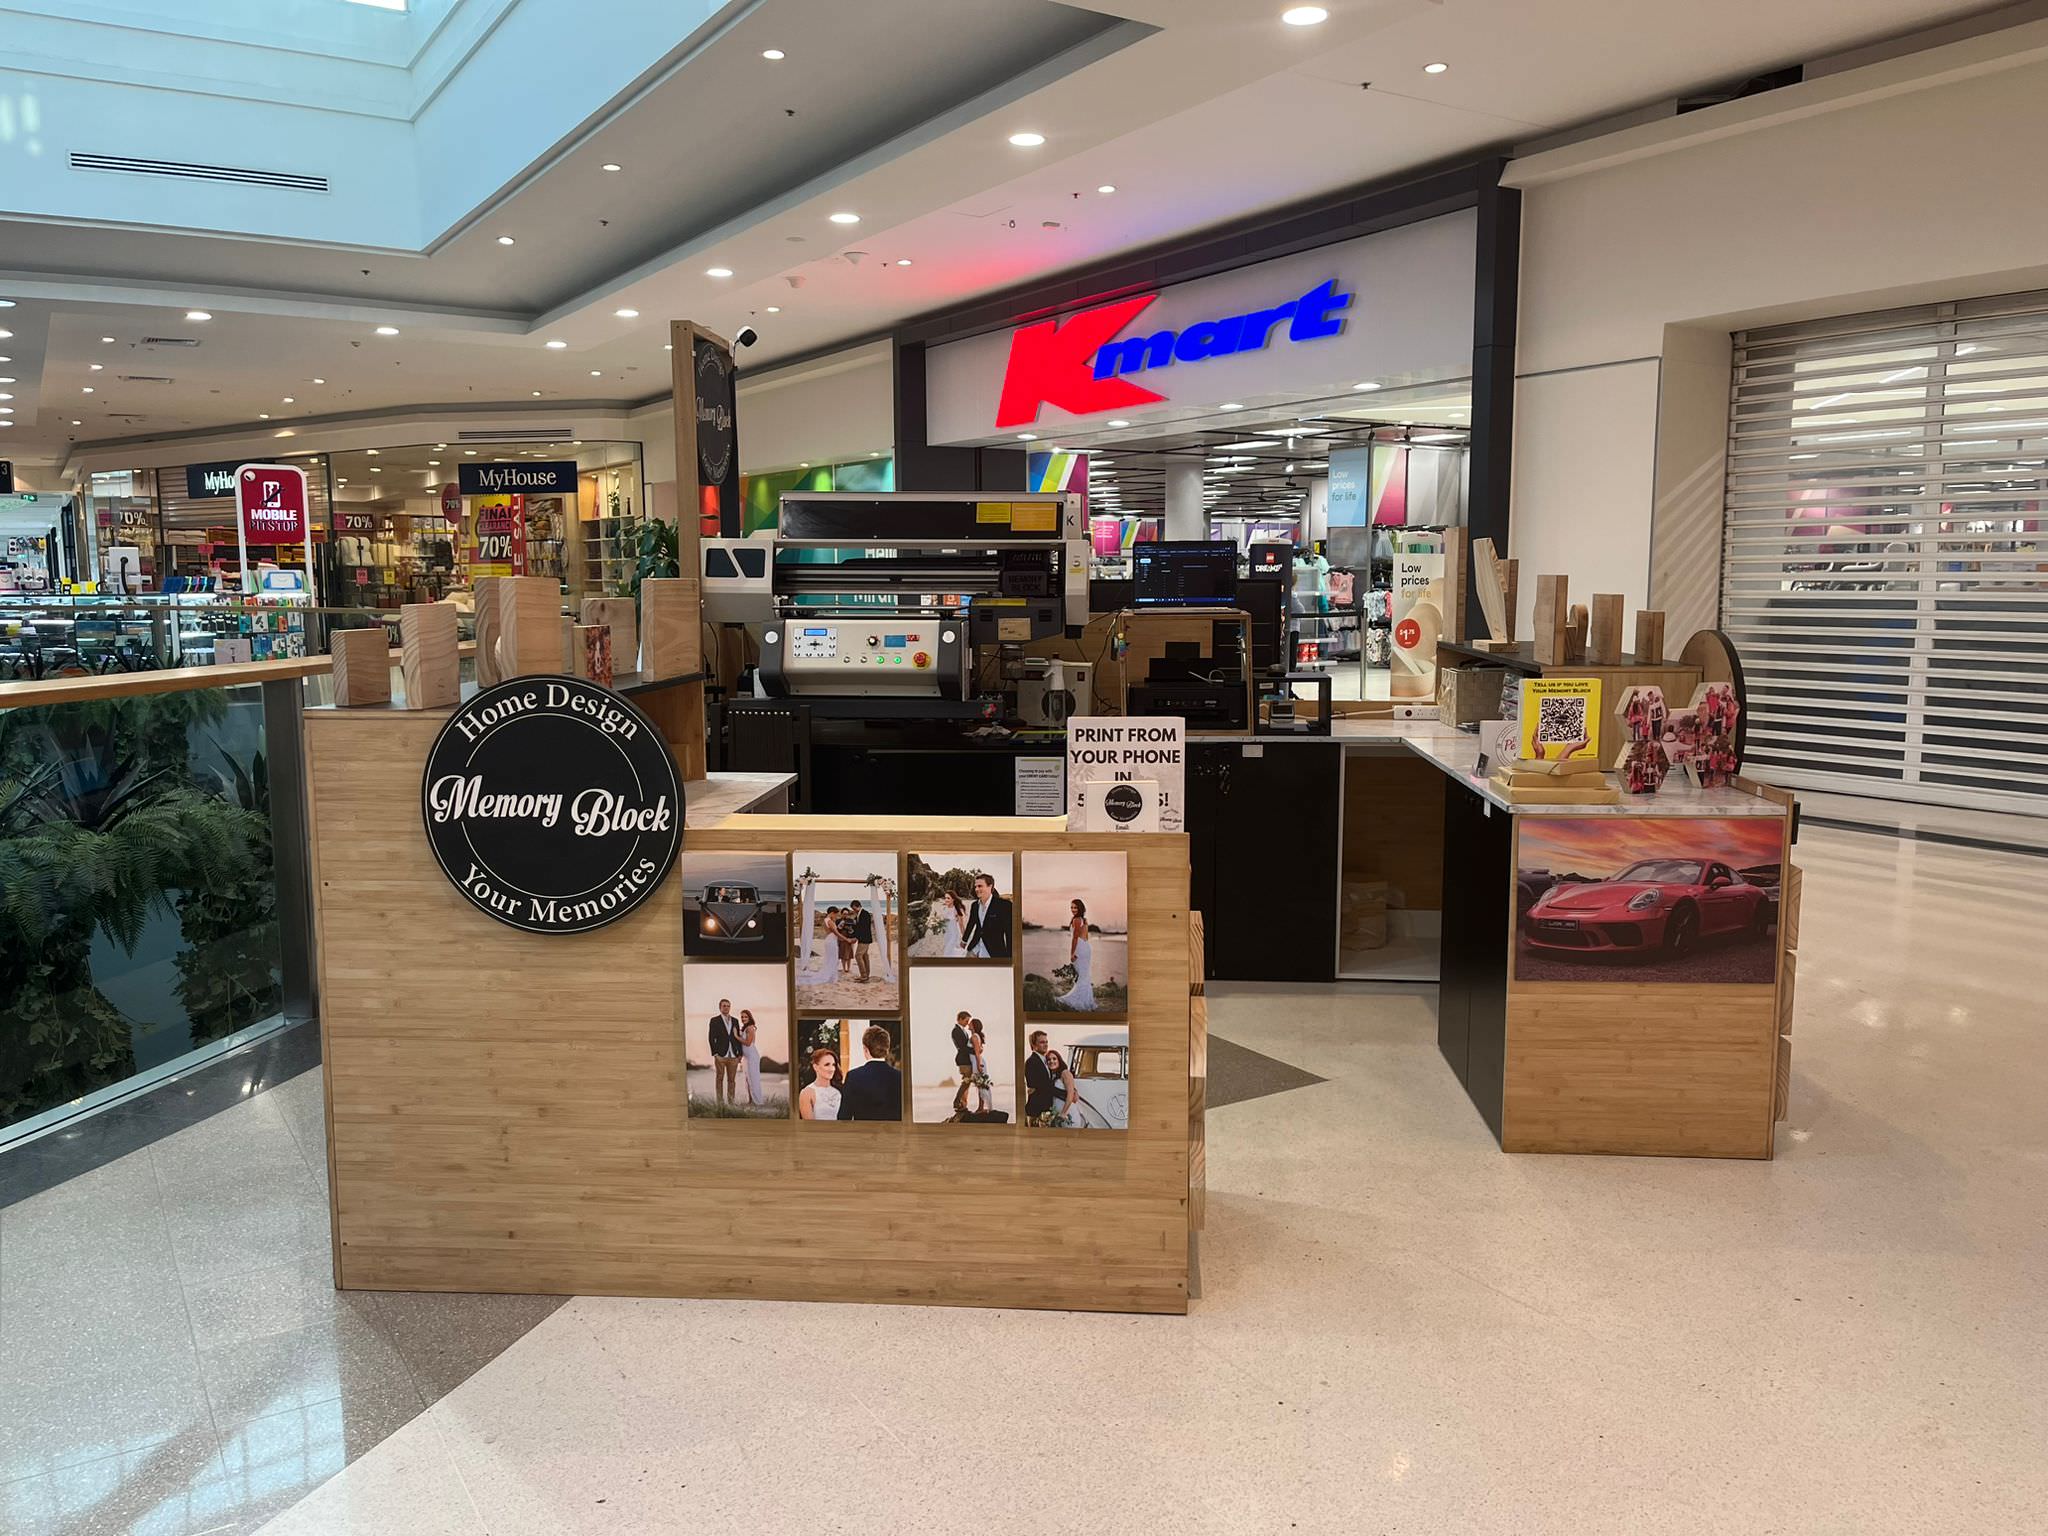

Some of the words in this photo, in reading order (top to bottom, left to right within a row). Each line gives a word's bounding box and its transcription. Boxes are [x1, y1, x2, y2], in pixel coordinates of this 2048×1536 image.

[996, 279, 1356, 427] Kmart
[204, 471, 235, 495] MyHo
[479, 468, 557, 491] MyHouse
[250, 509, 298, 520] MOBILE
[345, 514, 373, 529] 70%
[513, 494, 523, 540] SAL
[479, 536, 512, 558] 70%
[1401, 563, 1422, 573] Low
[1401, 575, 1430, 588] prices
[1401, 588, 1416, 599] for
[1418, 588, 1432, 598] life
[456, 690, 538, 743] Home
[545, 683, 640, 741] Design
[1075, 728, 1124, 742] PRINT
[1128, 728, 1177, 742] FROM
[1070, 750, 1119, 763] YOUR
[1123, 750, 1181, 763] PHONE
[1114, 772, 1132, 781] IN
[430, 774, 563, 828] Memory
[571, 788, 670, 837] Block
[460, 863, 523, 917] Your
[528, 857, 656, 923] Memories
